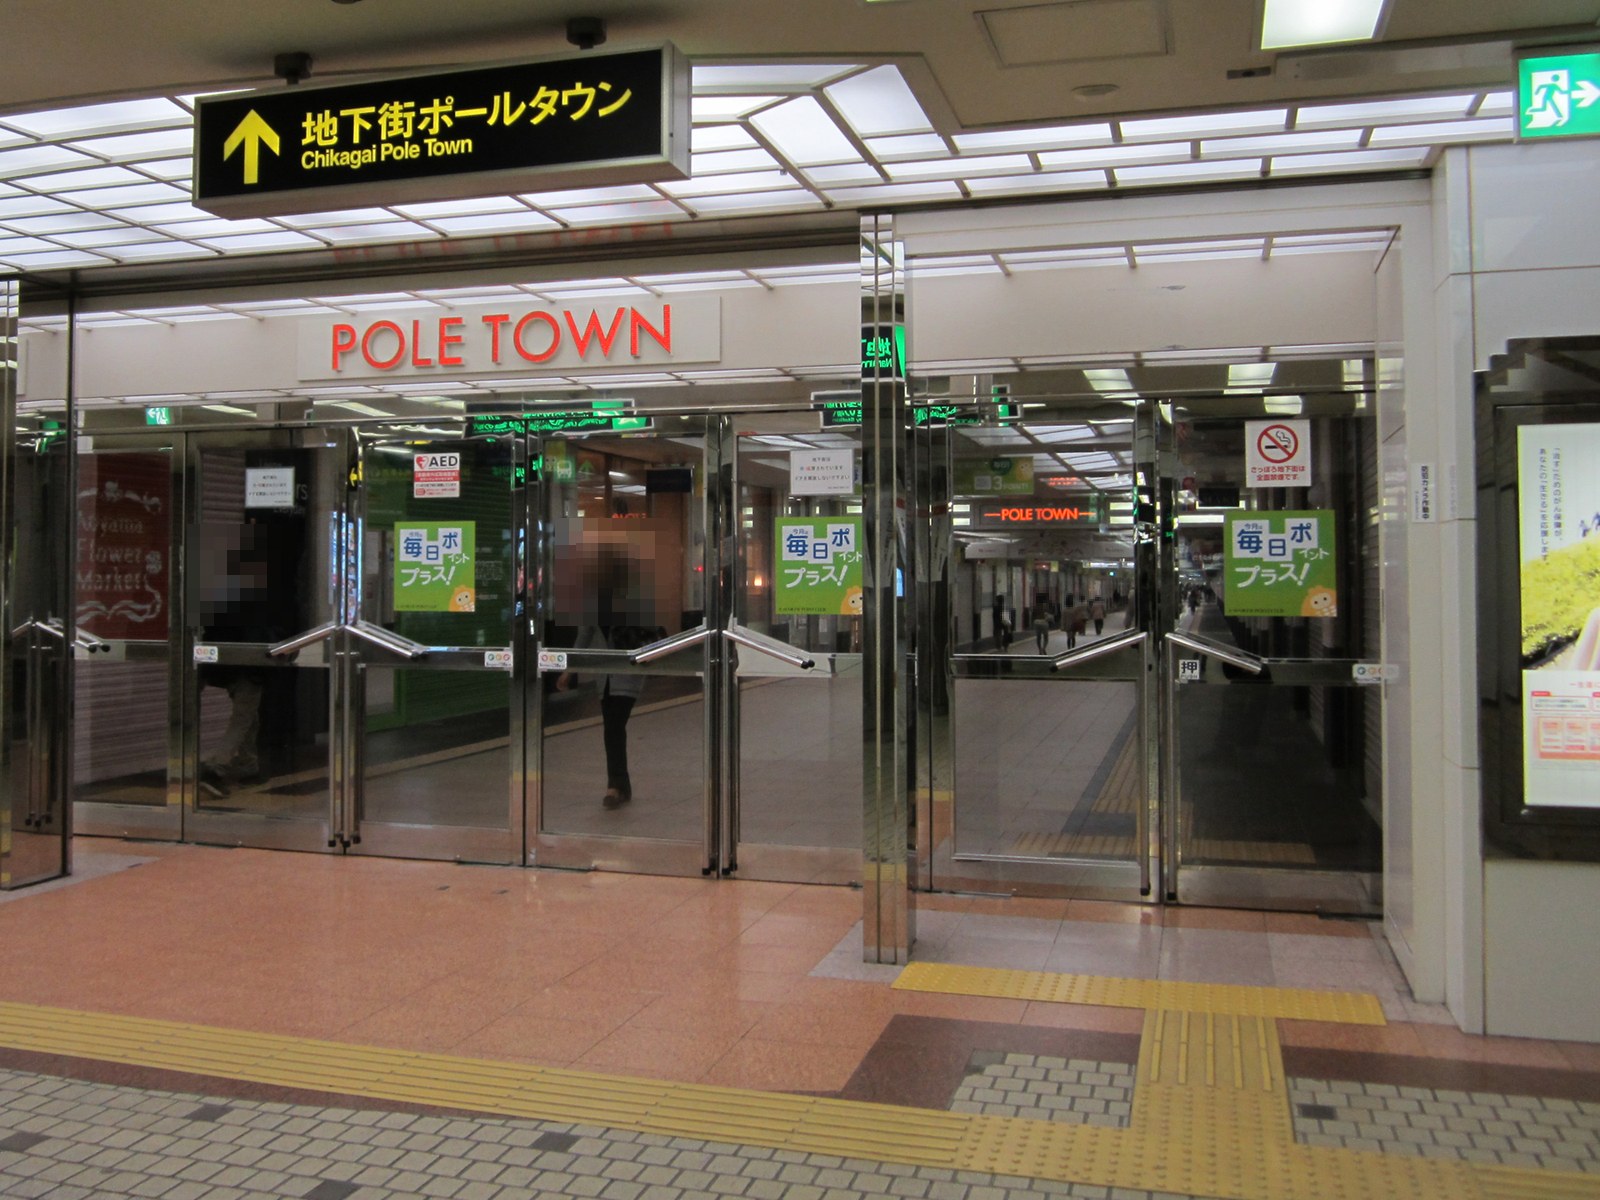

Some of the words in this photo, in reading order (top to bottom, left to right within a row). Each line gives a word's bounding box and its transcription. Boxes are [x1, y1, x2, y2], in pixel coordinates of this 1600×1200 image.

[301, 81, 632, 147] 地下街ポールタウン
[301, 145, 377, 169] Chikagai
[380, 141, 420, 161] Pole
[423, 137, 473, 156] Town
[331, 317, 465, 372] POLE
[481, 304, 672, 364] TOWN
[429, 455, 458, 467] AED
[1251, 465, 1306, 474] さっぽろ地下街は
[1001, 508, 1033, 521] POLE
[1035, 507, 1078, 520] TOWN
[1181, 661, 1198, 674] 押
